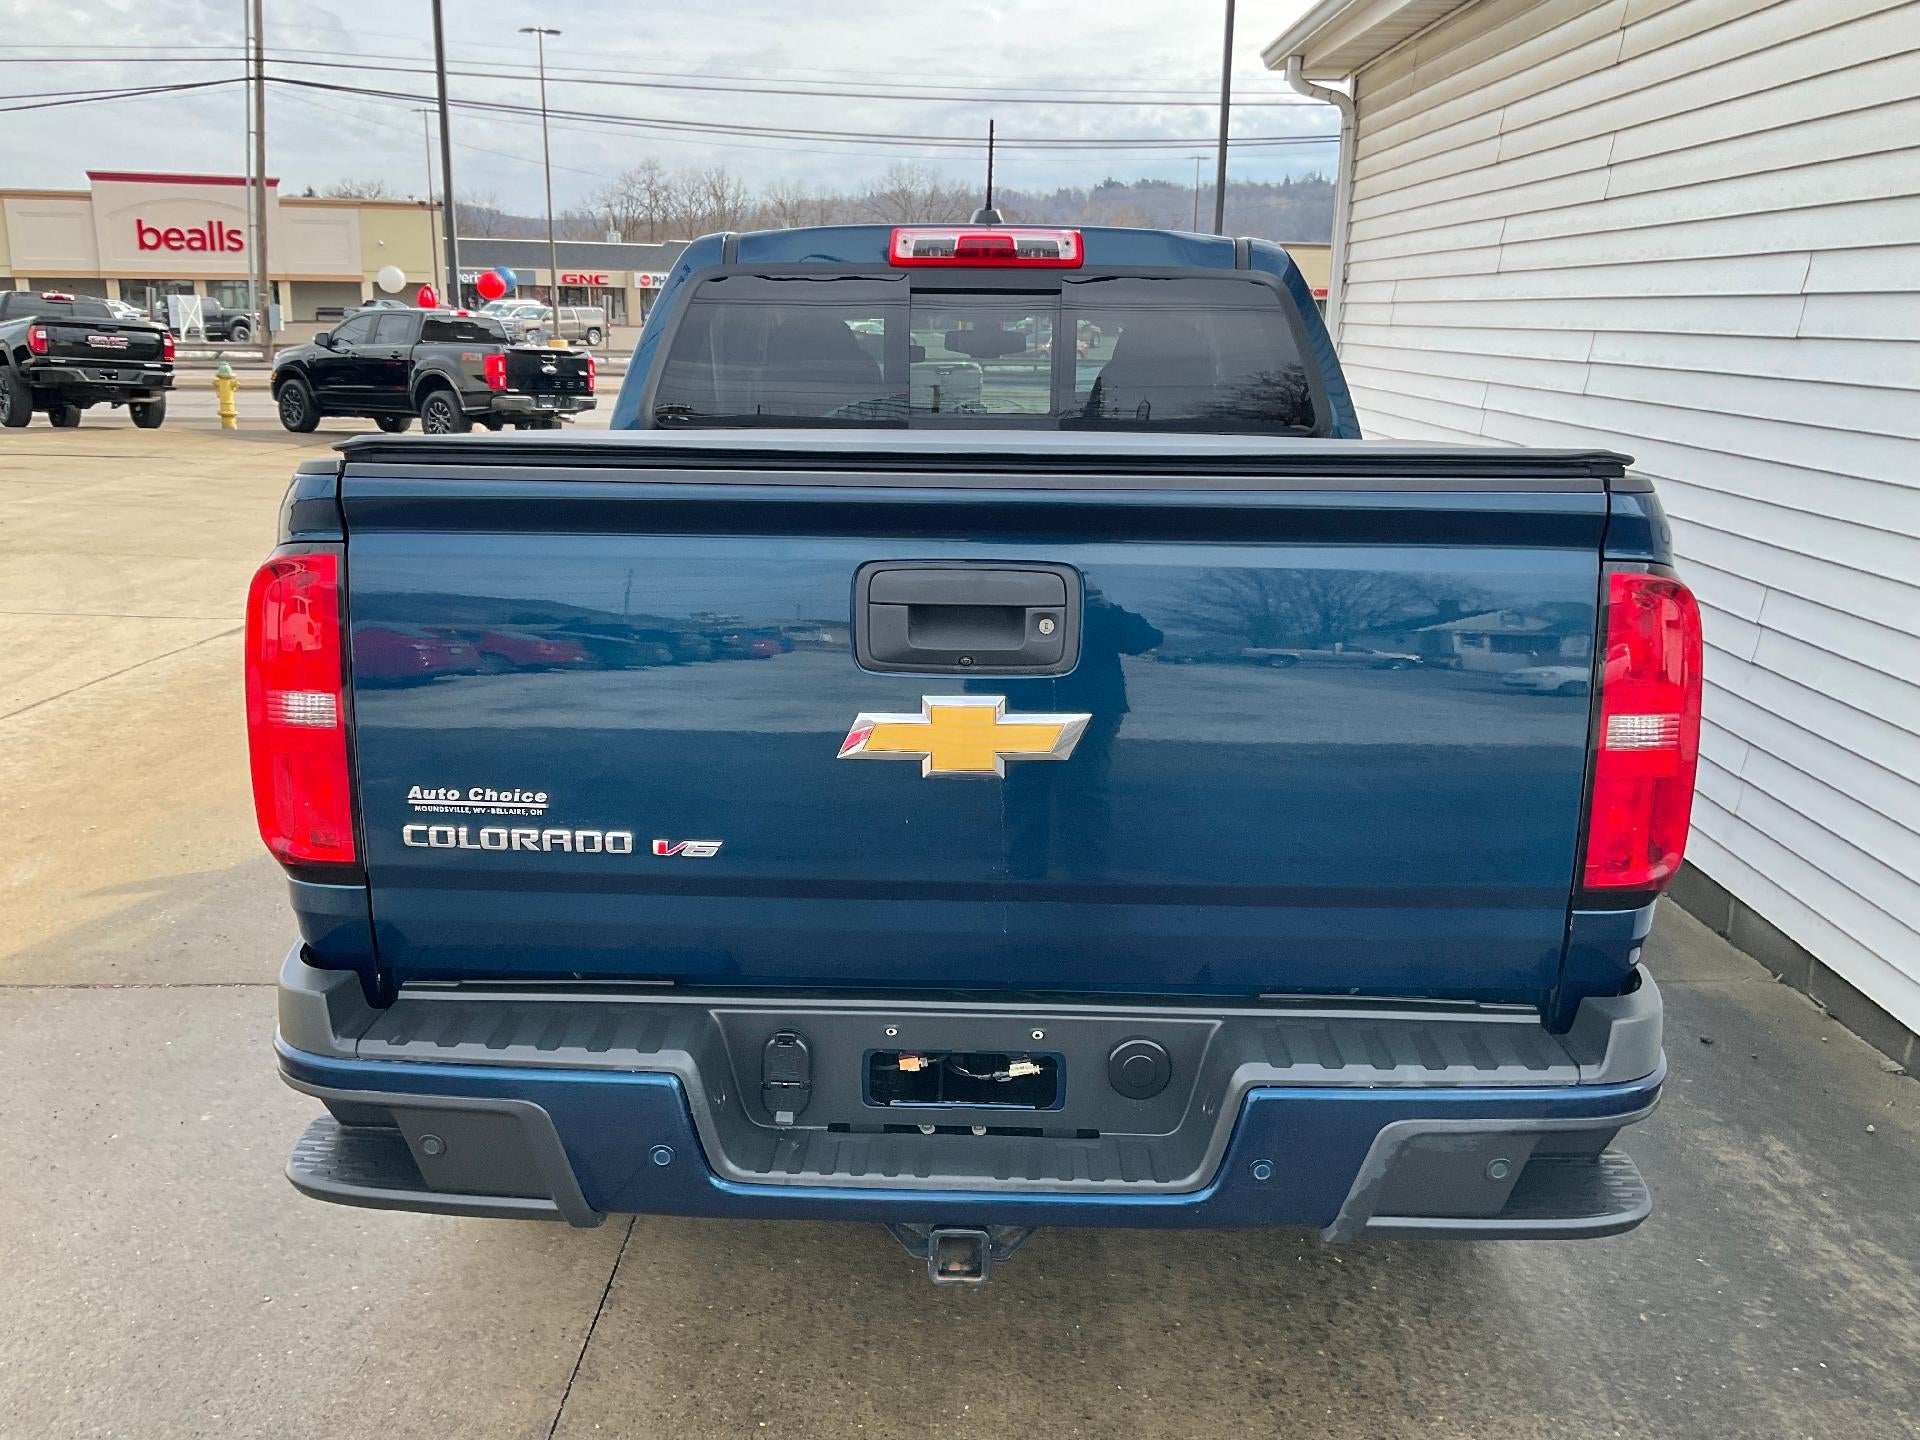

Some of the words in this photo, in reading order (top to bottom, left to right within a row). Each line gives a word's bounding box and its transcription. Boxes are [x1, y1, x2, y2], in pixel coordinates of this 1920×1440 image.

[135, 218, 245, 252] bealls
[561, 273, 609, 286] GNC
[407, 785, 460, 800] Auto
[468, 787, 548, 803] Choice
[414, 805, 472, 815] MOUNDSVILLE,
[530, 808, 543, 816] OH
[402, 824, 633, 854] COLORADO
[652, 839, 723, 857] V6
